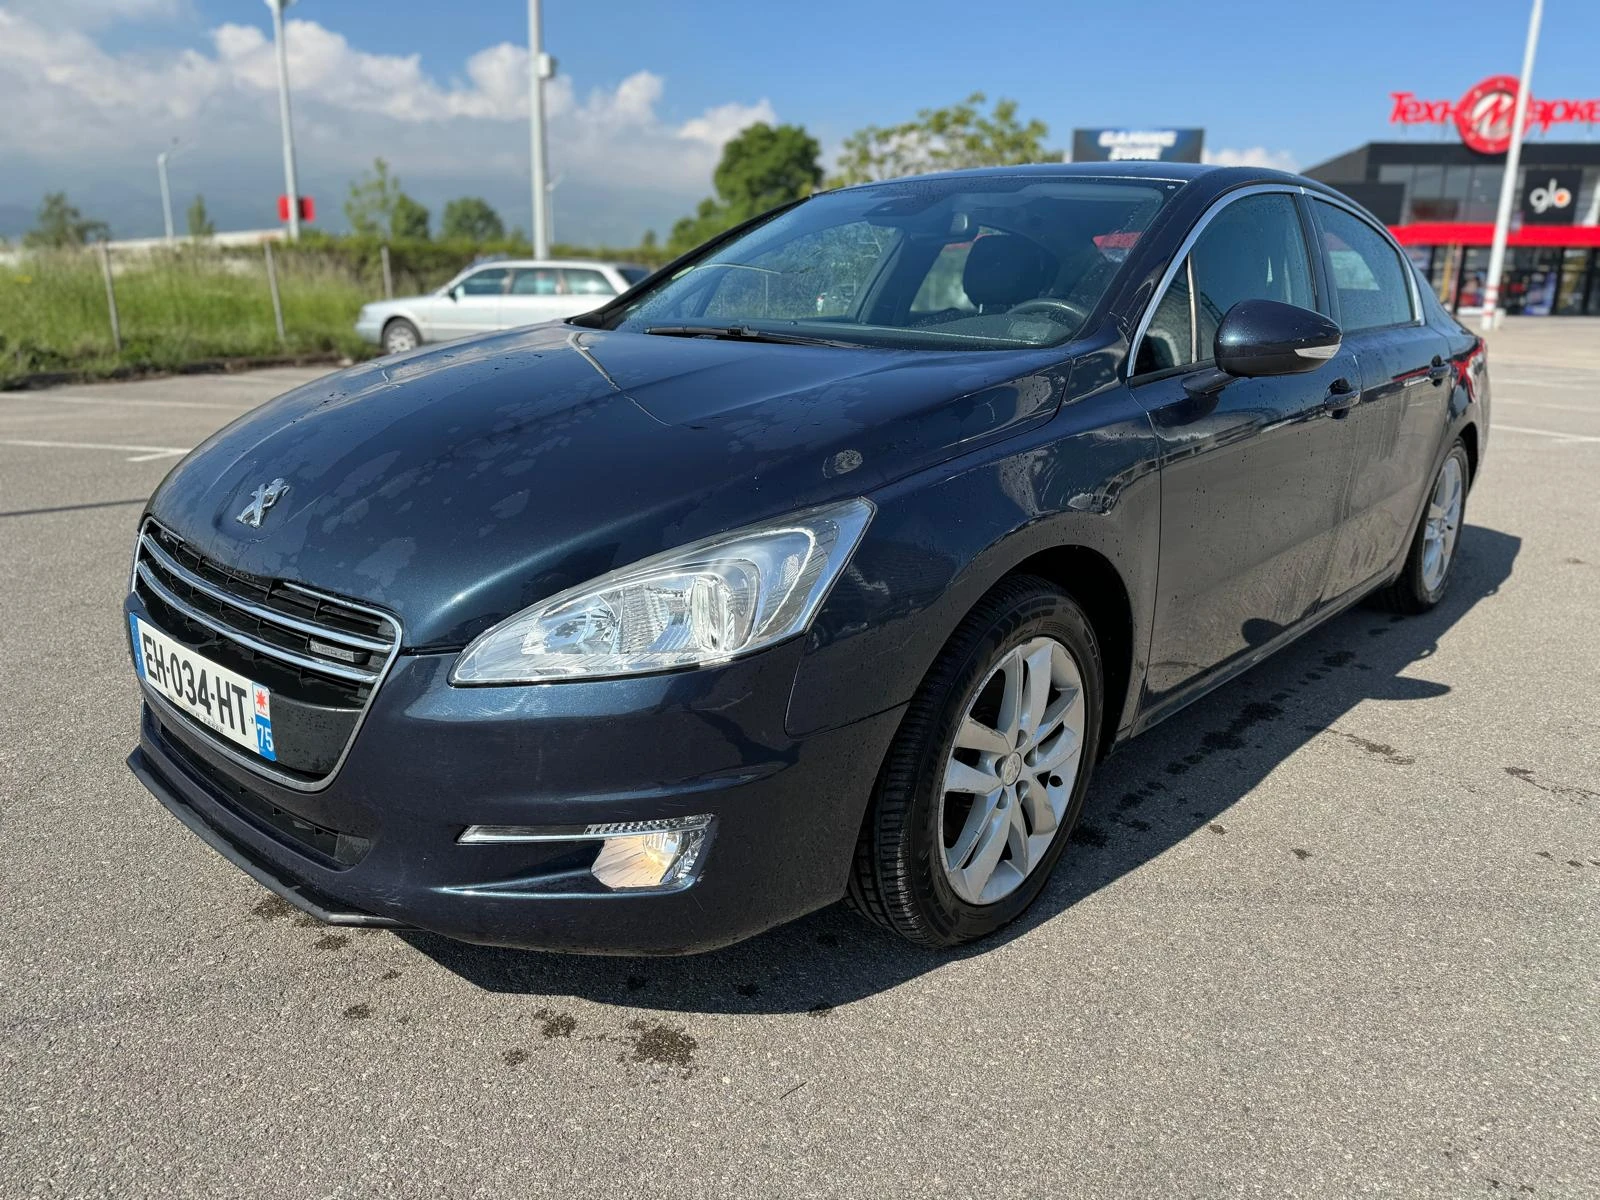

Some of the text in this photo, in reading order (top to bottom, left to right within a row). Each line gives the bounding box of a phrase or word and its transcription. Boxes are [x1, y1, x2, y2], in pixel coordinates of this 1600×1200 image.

[1529, 178, 1572, 214] glo
[142, 632, 248, 736] EH-034-HT
[257, 724, 274, 752] 75
